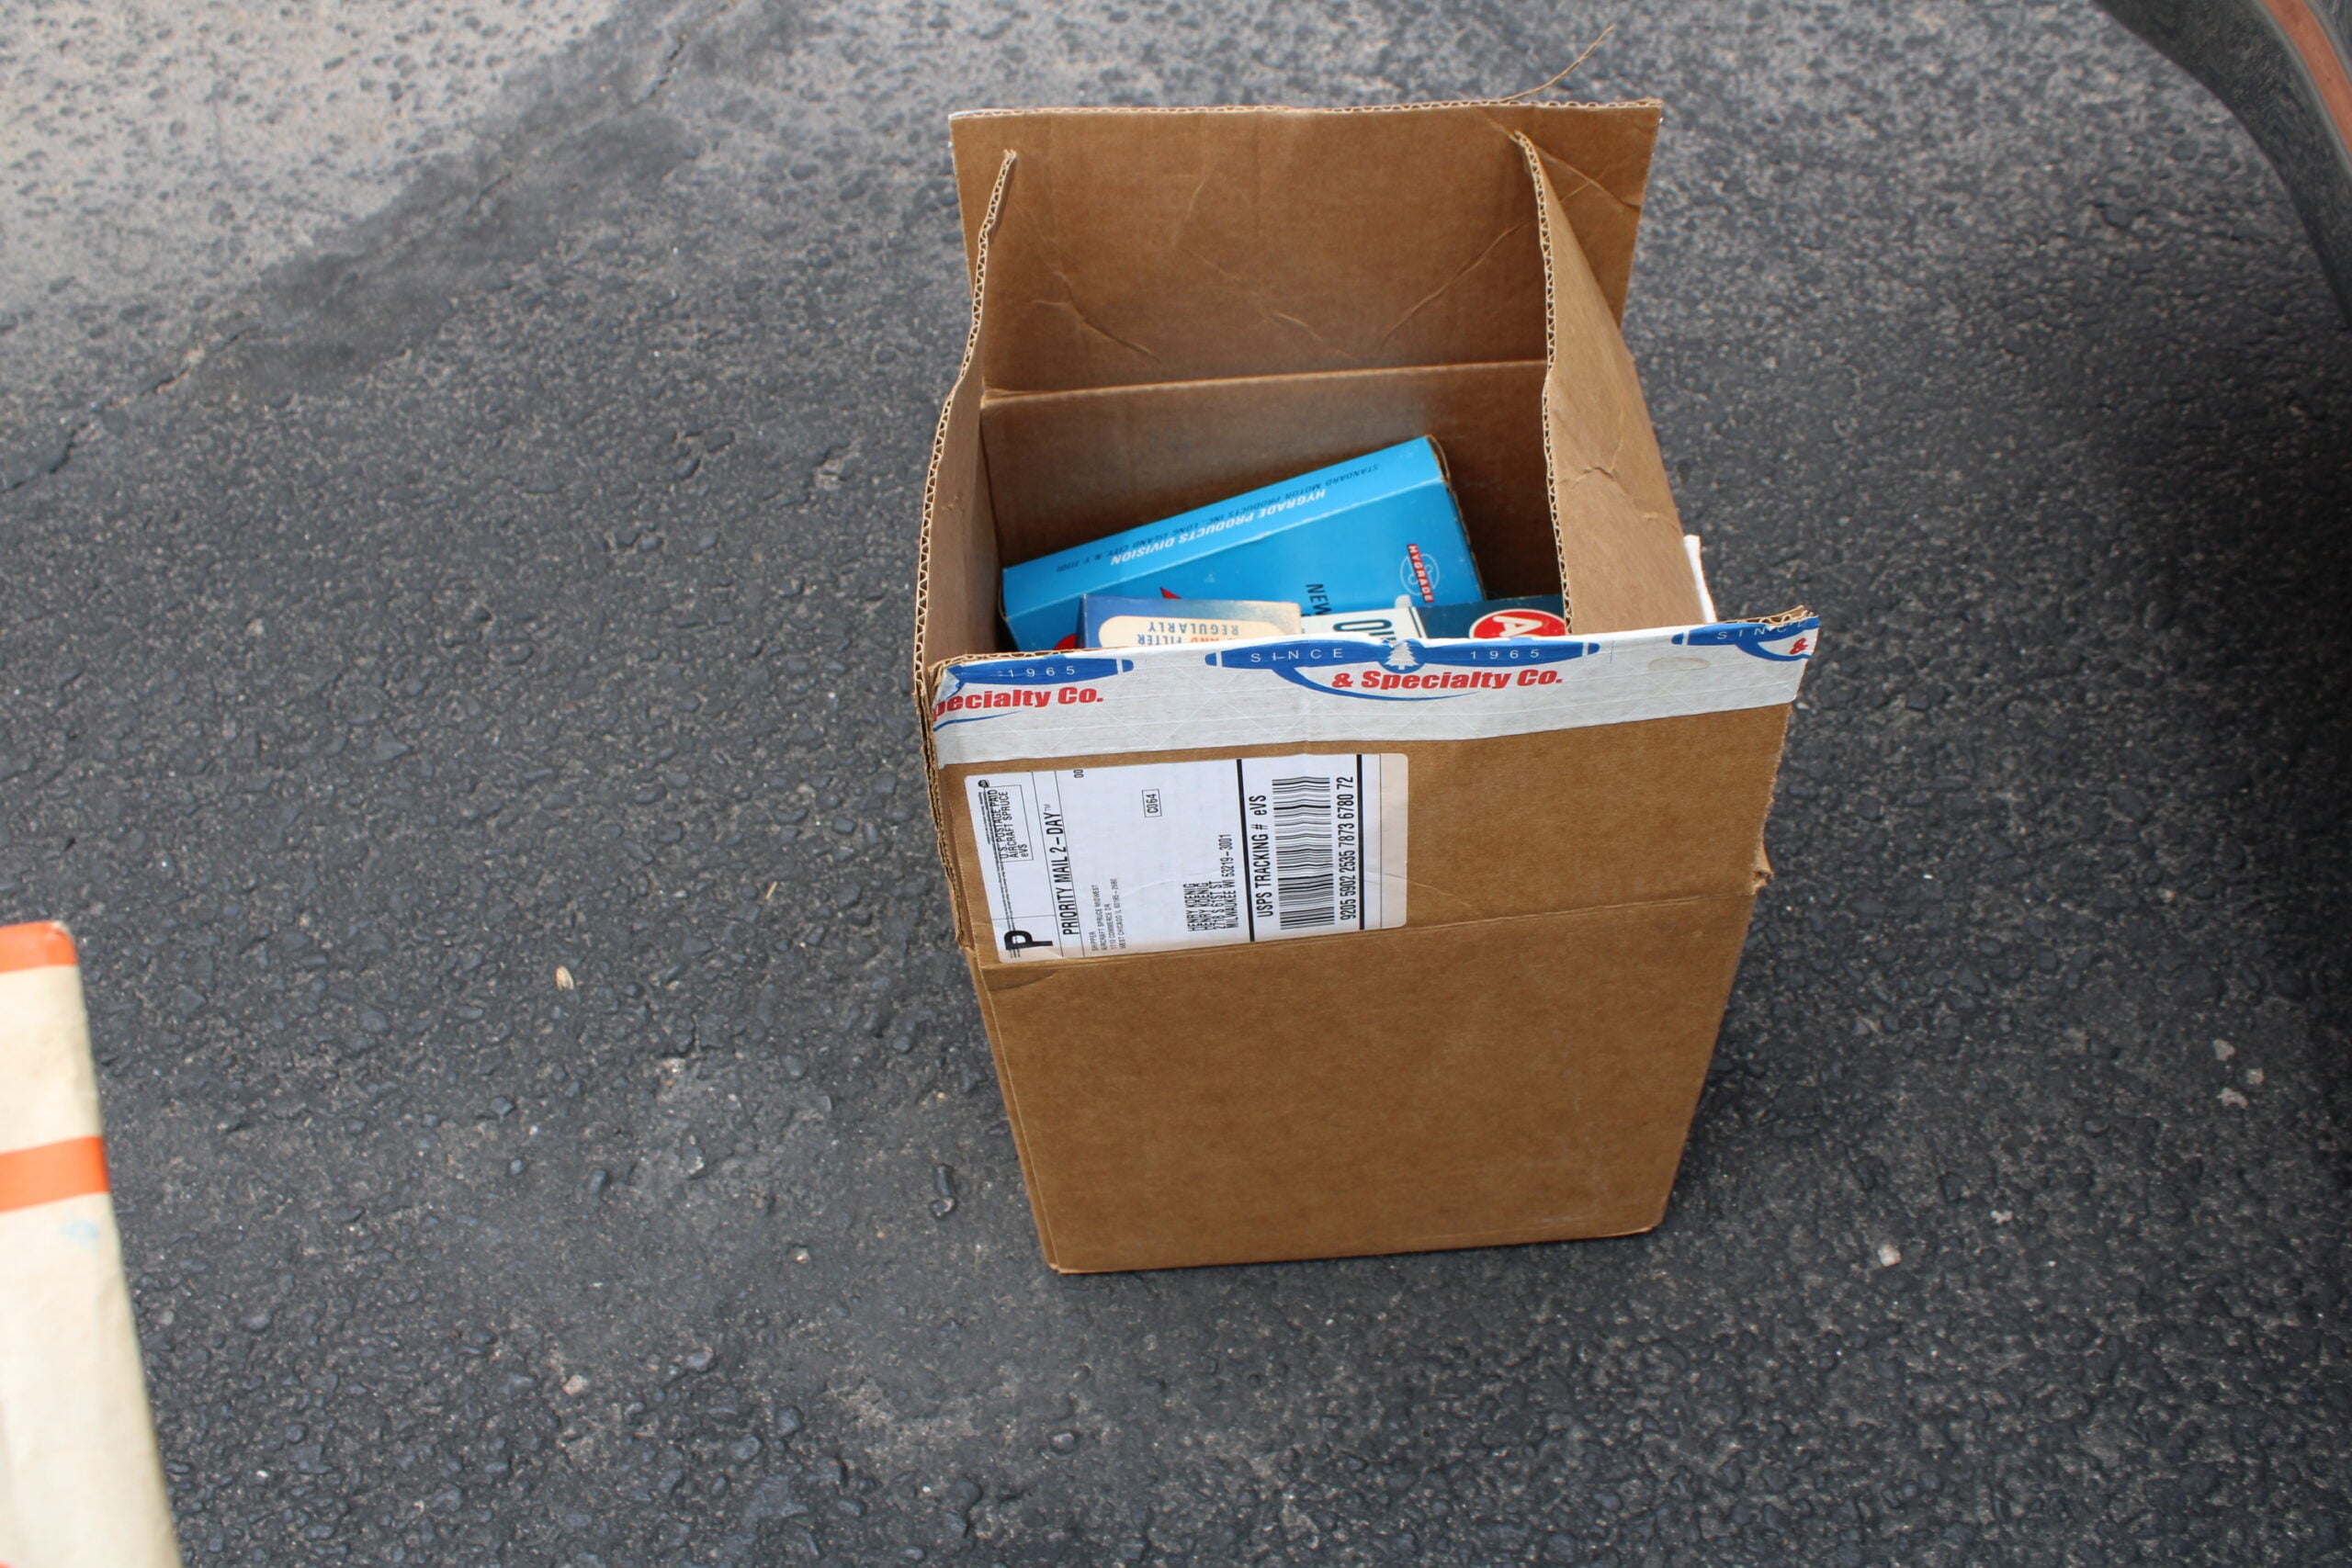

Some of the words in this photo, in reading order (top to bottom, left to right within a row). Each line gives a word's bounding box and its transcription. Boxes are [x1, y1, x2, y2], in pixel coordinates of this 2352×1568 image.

[1324, 464, 1379, 487] STANDARD
[1284, 483, 1321, 498] MOTOR
[1227, 496, 1282, 517] PRODUCTS
[1257, 489, 1327, 520] HYGRADE
[1180, 511, 1255, 544] PRODUCTS
[1110, 536, 1175, 566] DIVISION
[1133, 531, 1168, 549] ISLAND
[1407, 544, 1435, 602] HYGRADE
[1137, 634, 1182, 646] FILTER
[1148, 622, 1238, 636] REGULARLY
[1250, 648, 1344, 663] SINCE
[1470, 648, 1541, 660] 1965
[1331, 672, 1354, 689] &
[1361, 670, 1510, 692] Specialty
[1517, 670, 1563, 688] Co.
[933, 688, 1051, 721] pecialty
[1057, 686, 1103, 705] Co.
[1336, 776, 1353, 790] 72
[987, 789, 999, 807] PAID
[998, 792, 1012, 821] SPRUCE
[1249, 795, 1268, 816] eVS
[1336, 794, 1354, 819] 6780
[990, 809, 1005, 842] POSTAGE
[1337, 822, 1355, 848] 7873
[1004, 823, 1018, 858] AIRCRAFT
[1018, 843, 1029, 858] eVS
[1051, 856, 1072, 883] MAIL
[1250, 833, 1272, 888] TRACKING
[1338, 850, 1355, 874] 2535
[1195, 882, 1211, 908] KOENIG
[1208, 881, 1223, 889] ST
[1221, 879, 1236, 888] WI
[1339, 874, 1356, 897] 5902
[1091, 884, 1102, 908] MIDWEST
[1182, 883, 1198, 908] KOENIG
[1210, 891, 1224, 908] 61ST
[1255, 892, 1273, 918] USPS
[1055, 886, 1080, 935] PRIORITY
[1095, 908, 1104, 928] SPRUCE
[1185, 909, 1199, 931] HENRY
[1197, 908, 1214, 931] HENRY
[1223, 890, 1239, 930] MILWAUKEE
[1339, 898, 1356, 920] 9205
[1105, 912, 1115, 939] COMMERCE
[1115, 915, 1125, 936] CHICAGO
[1212, 914, 1226, 930] 2718
[1004, 931, 1053, 951] P
[1089, 931, 1099, 952] SHIPPER
[1098, 928, 1108, 951] AIRCRAFT
[1118, 936, 1126, 949] WEST
